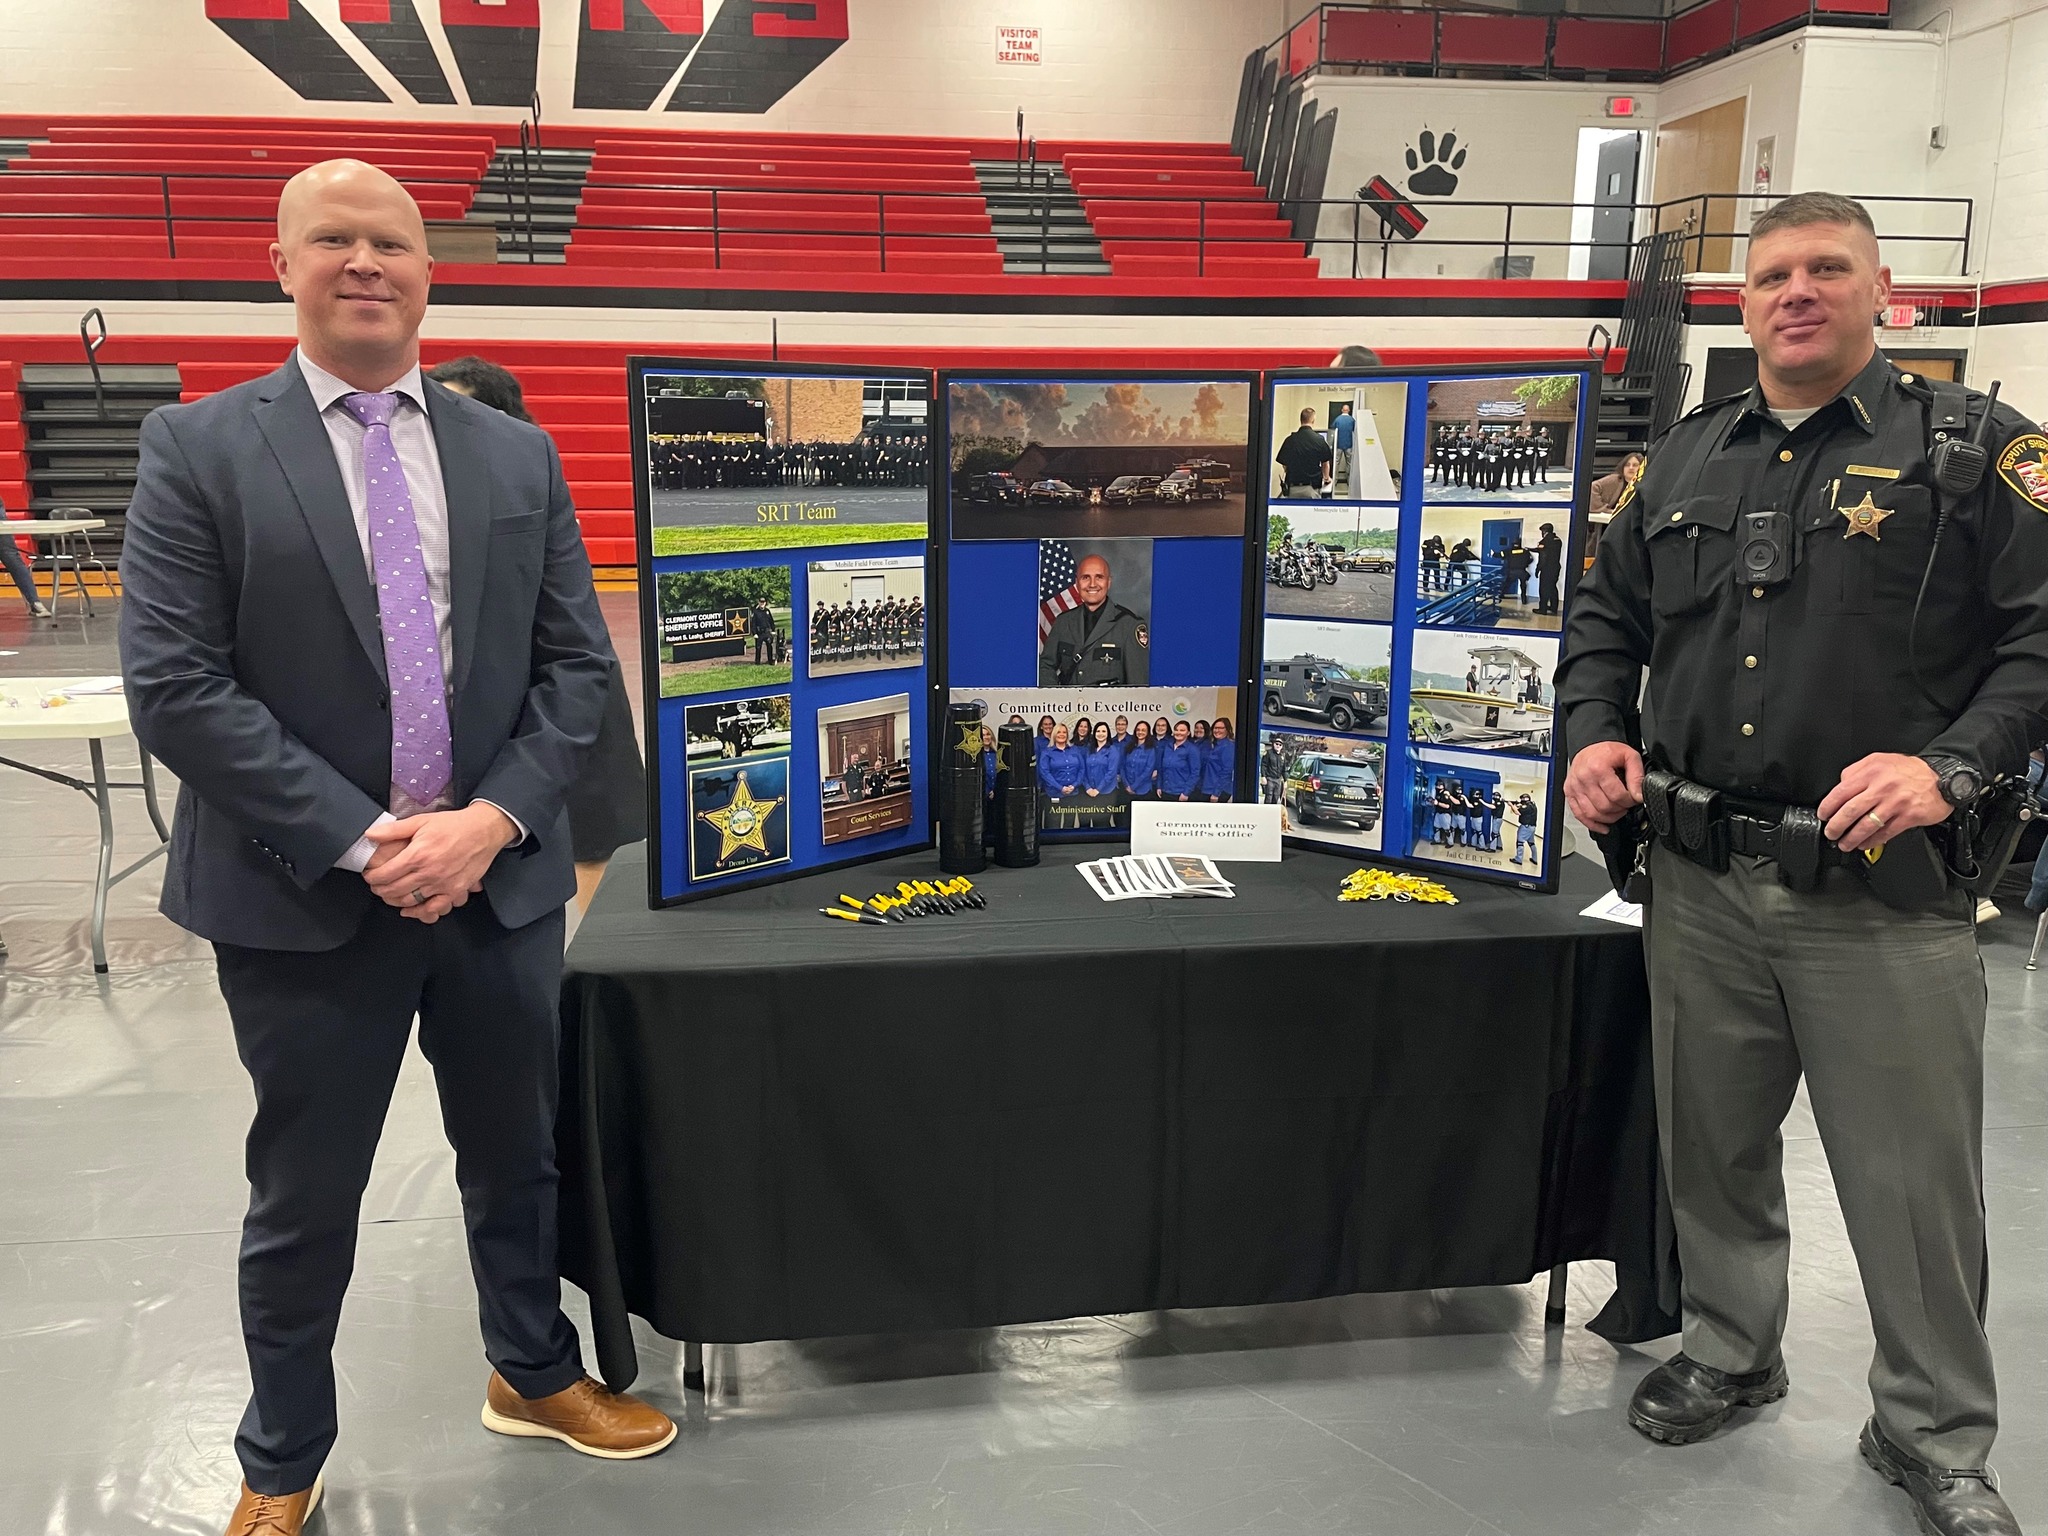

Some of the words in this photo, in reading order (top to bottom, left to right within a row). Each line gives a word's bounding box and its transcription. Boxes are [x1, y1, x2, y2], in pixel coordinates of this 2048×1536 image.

[1000, 28, 1038, 38] VISITOR
[1006, 40, 1033, 50] TEAM
[998, 51, 1040, 62] SEATING
[1892, 307, 1914, 325] EXIT
[2001, 441, 2028, 470] DEPUTY
[757, 503, 791, 522] SRT
[795, 502, 837, 521] Team
[665, 615, 698, 625] CLERMONT
[698, 612, 722, 621] COUNTY
[664, 621, 699, 632] SHERIFF'S
[699, 619, 724, 629] OFFICE
[666, 634, 683, 642] Robert
[704, 630, 725, 639] SHERIFF
[998, 701, 1073, 714] Committed
[1076, 702, 1089, 713] to
[1094, 701, 1162, 714] Excellence
[1050, 805, 1105, 814] Administrative
[1106, 804, 1127, 813] Staff
[850, 814, 868, 825] Court
[868, 809, 892, 821] Services
[1156, 821, 1213, 829] Clermont
[1215, 822, 1258, 830] County
[1160, 829, 1214, 838] Sheriff's
[1217, 830, 1253, 838] Office
[1446, 850, 1457, 859] Jail
[728, 859, 745, 867] Drone
[746, 855, 758, 864] Unit
